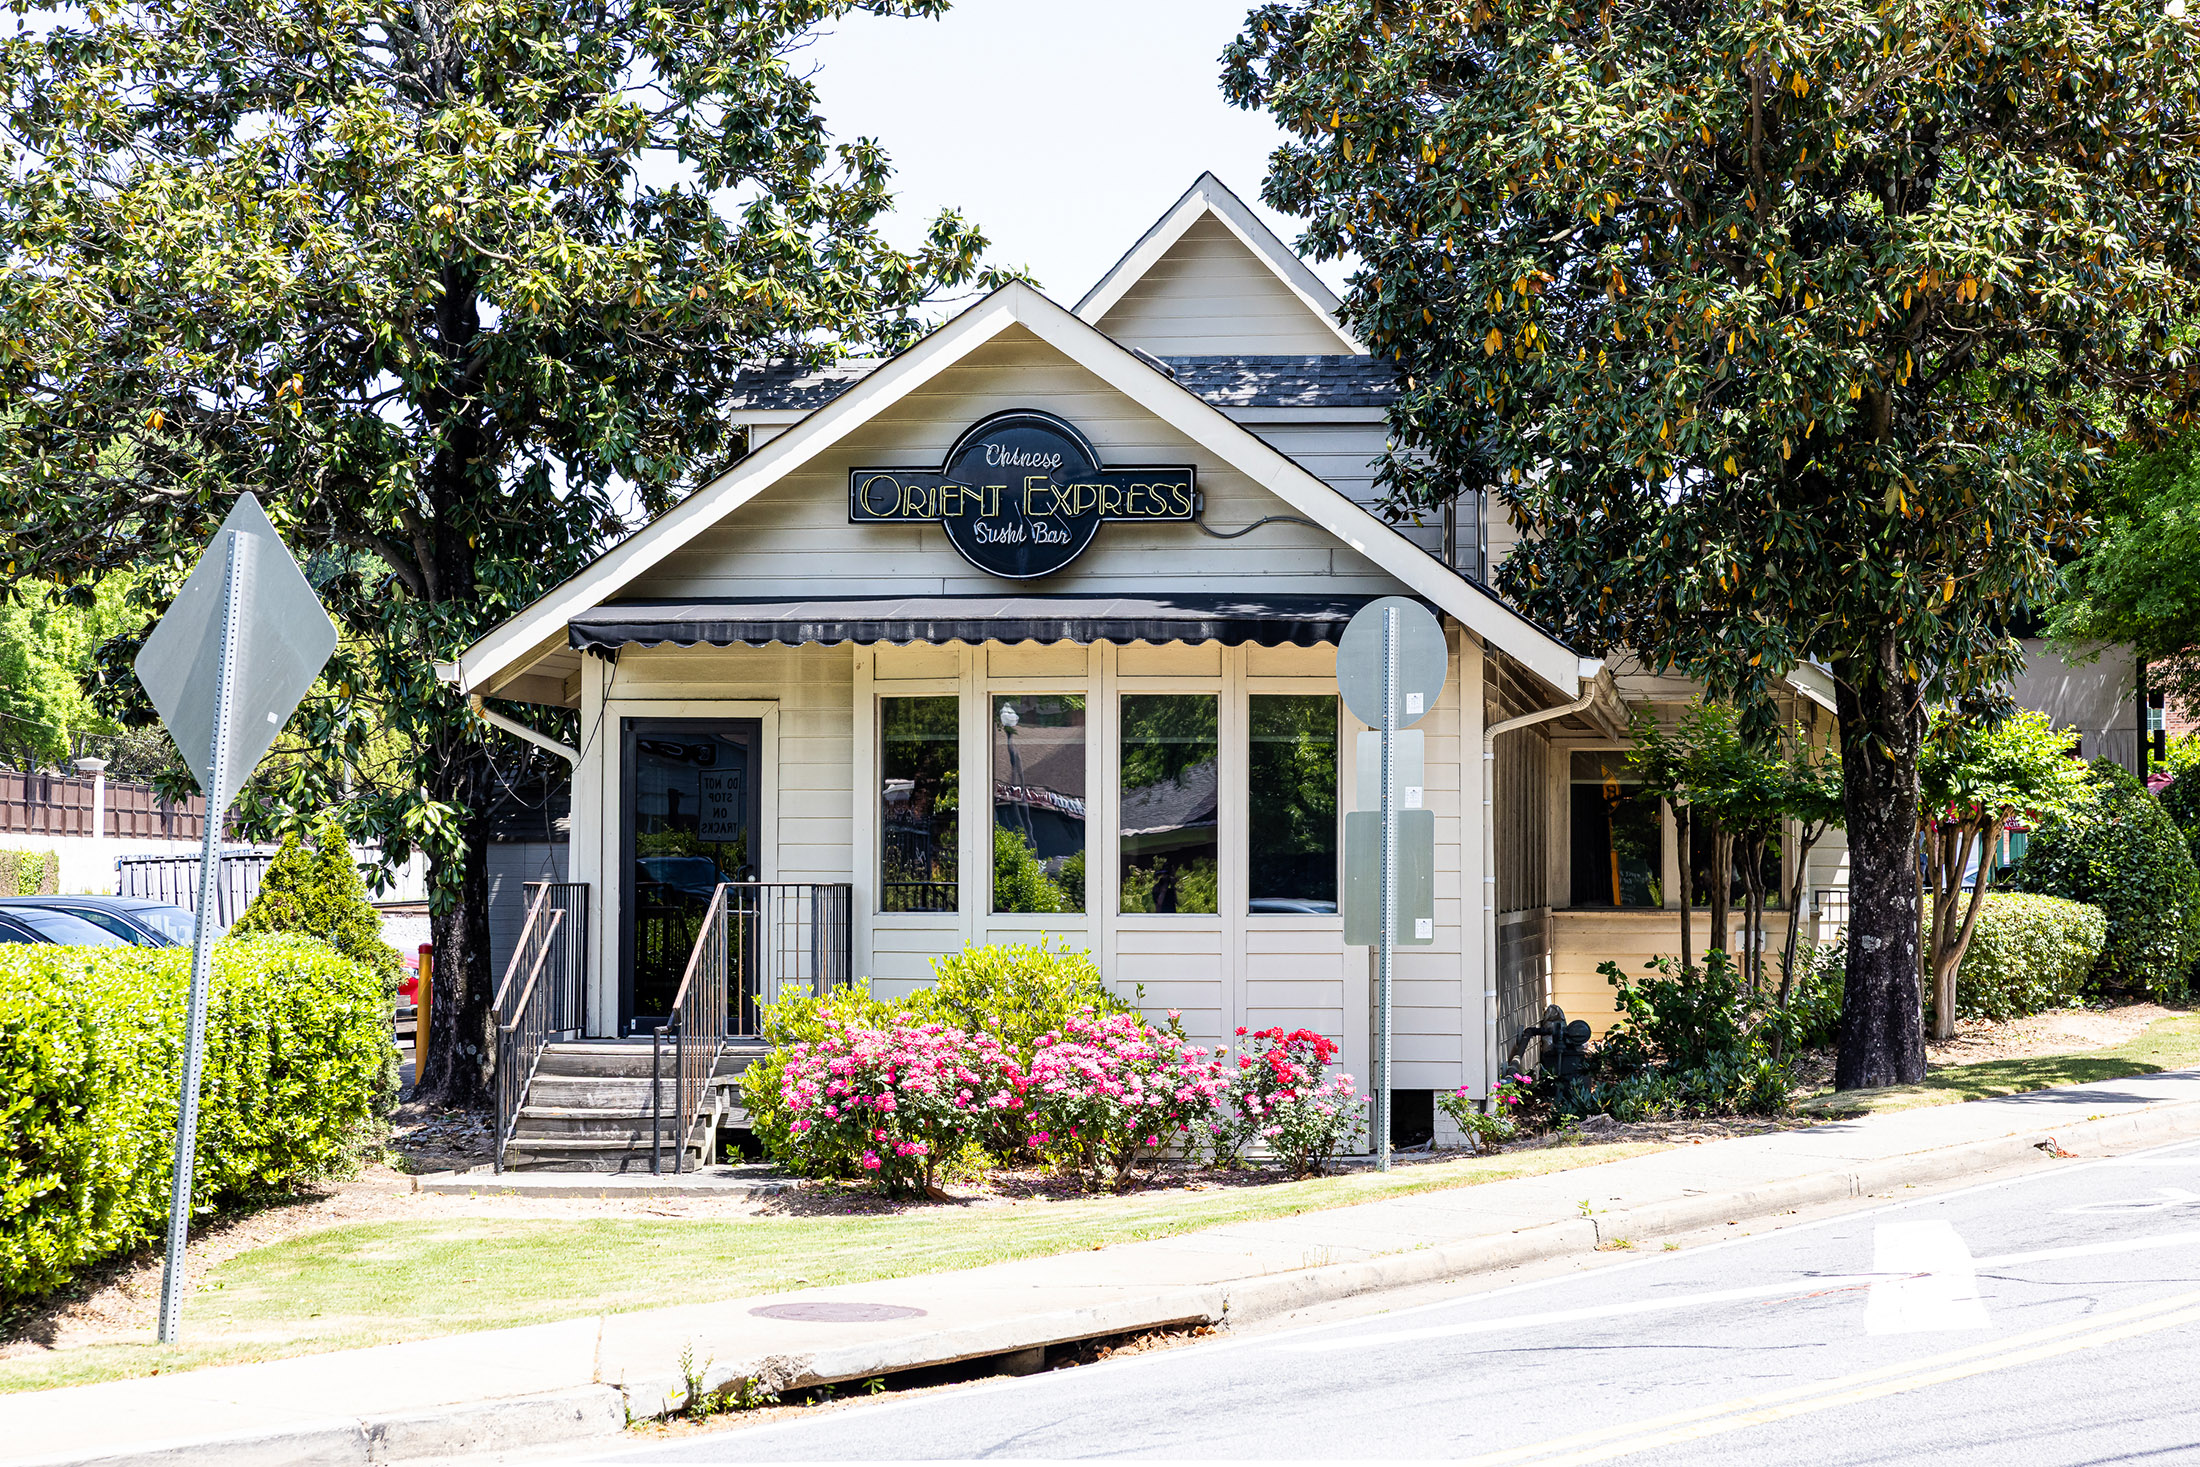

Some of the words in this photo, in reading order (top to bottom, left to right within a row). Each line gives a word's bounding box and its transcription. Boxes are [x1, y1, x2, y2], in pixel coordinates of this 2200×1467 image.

[985, 443, 1063, 469] Chinese
[975, 521, 1027, 544] Sushi
[1032, 521, 1072, 544] Bar
